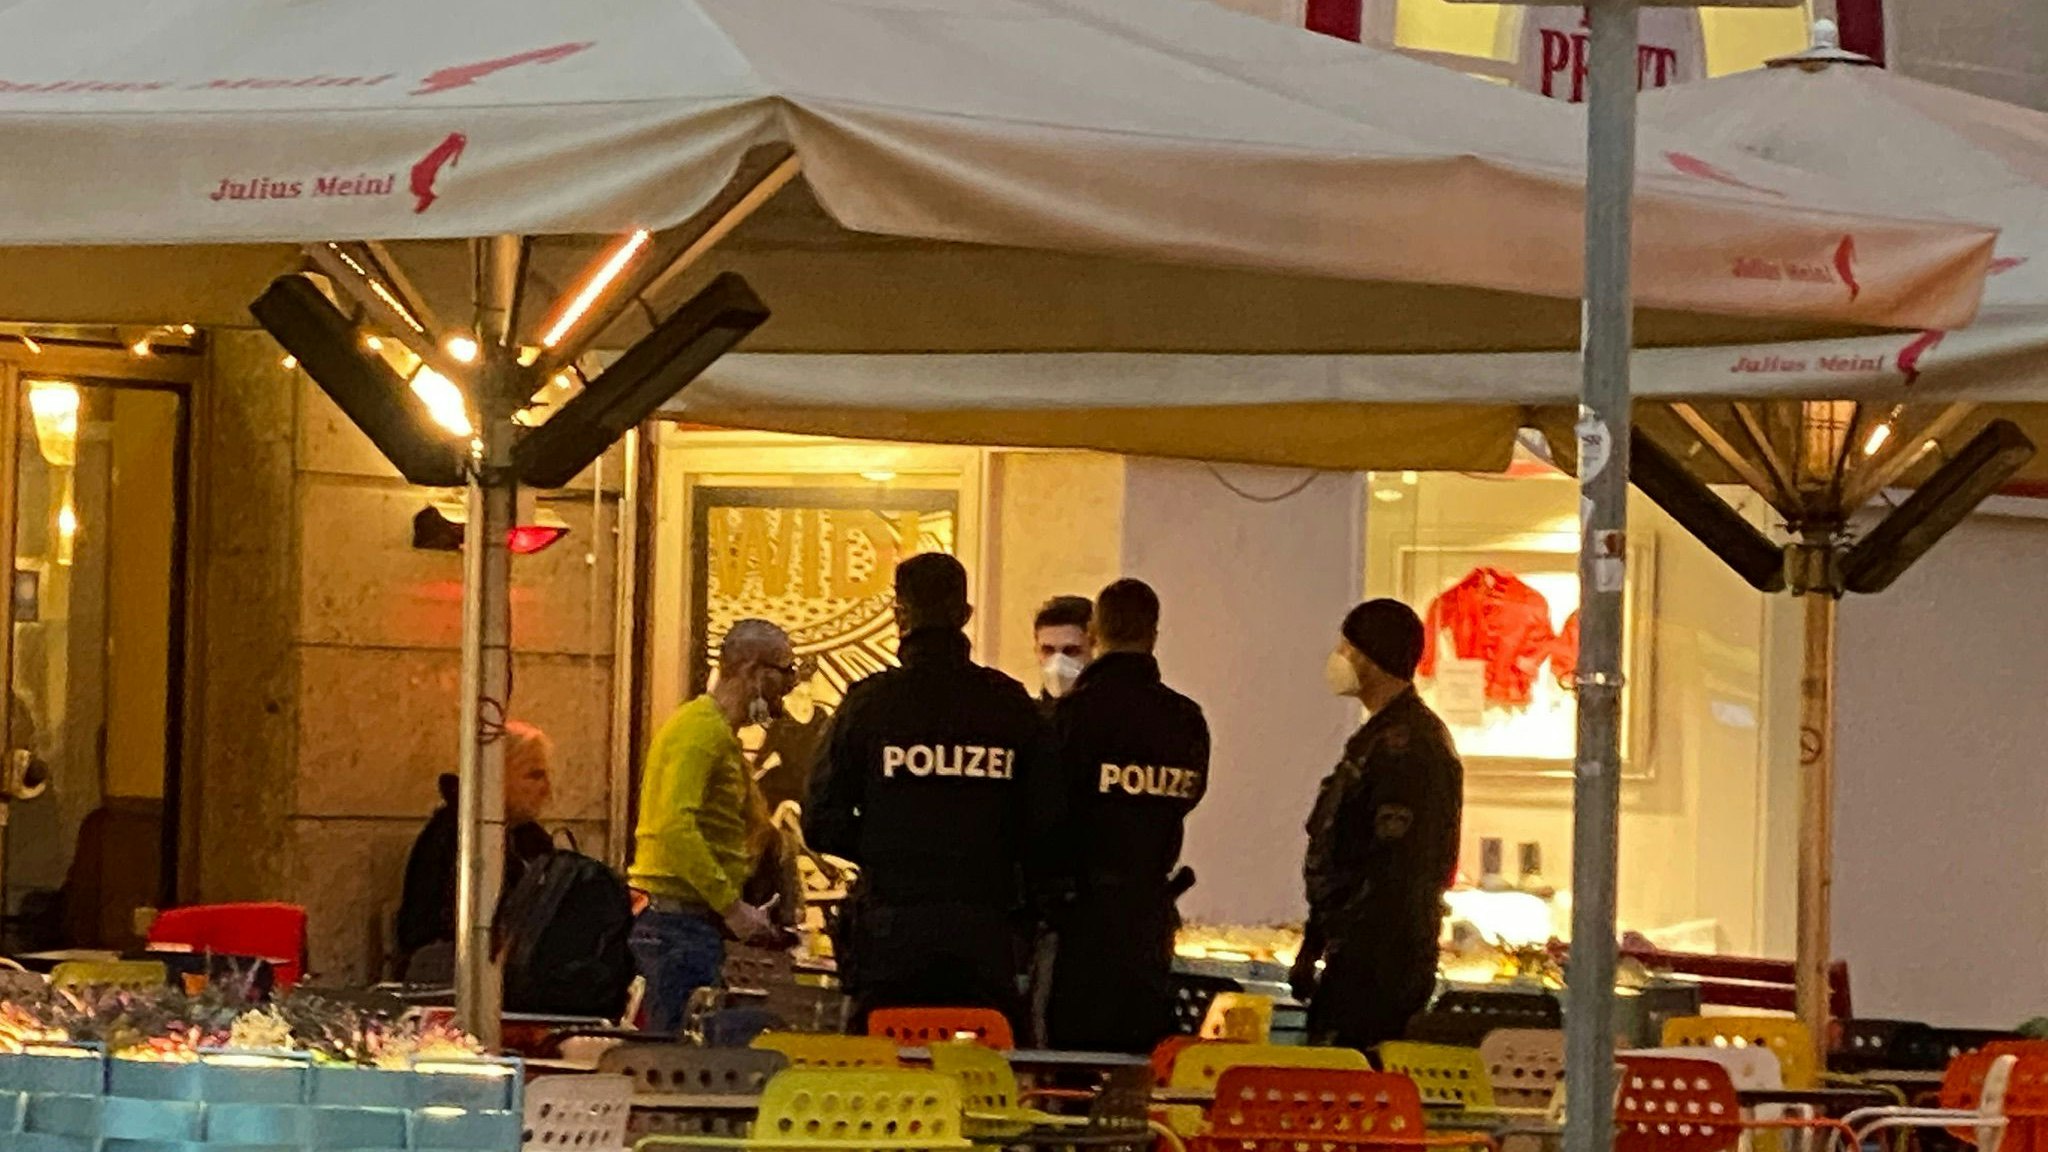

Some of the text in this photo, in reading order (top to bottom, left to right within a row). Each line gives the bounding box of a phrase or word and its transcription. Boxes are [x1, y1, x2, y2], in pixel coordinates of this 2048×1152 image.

[209, 173, 396, 201] Julius Meinl
[1731, 354, 1885, 373] Julius Meinl
[883, 744, 1014, 780] POLIZEI
